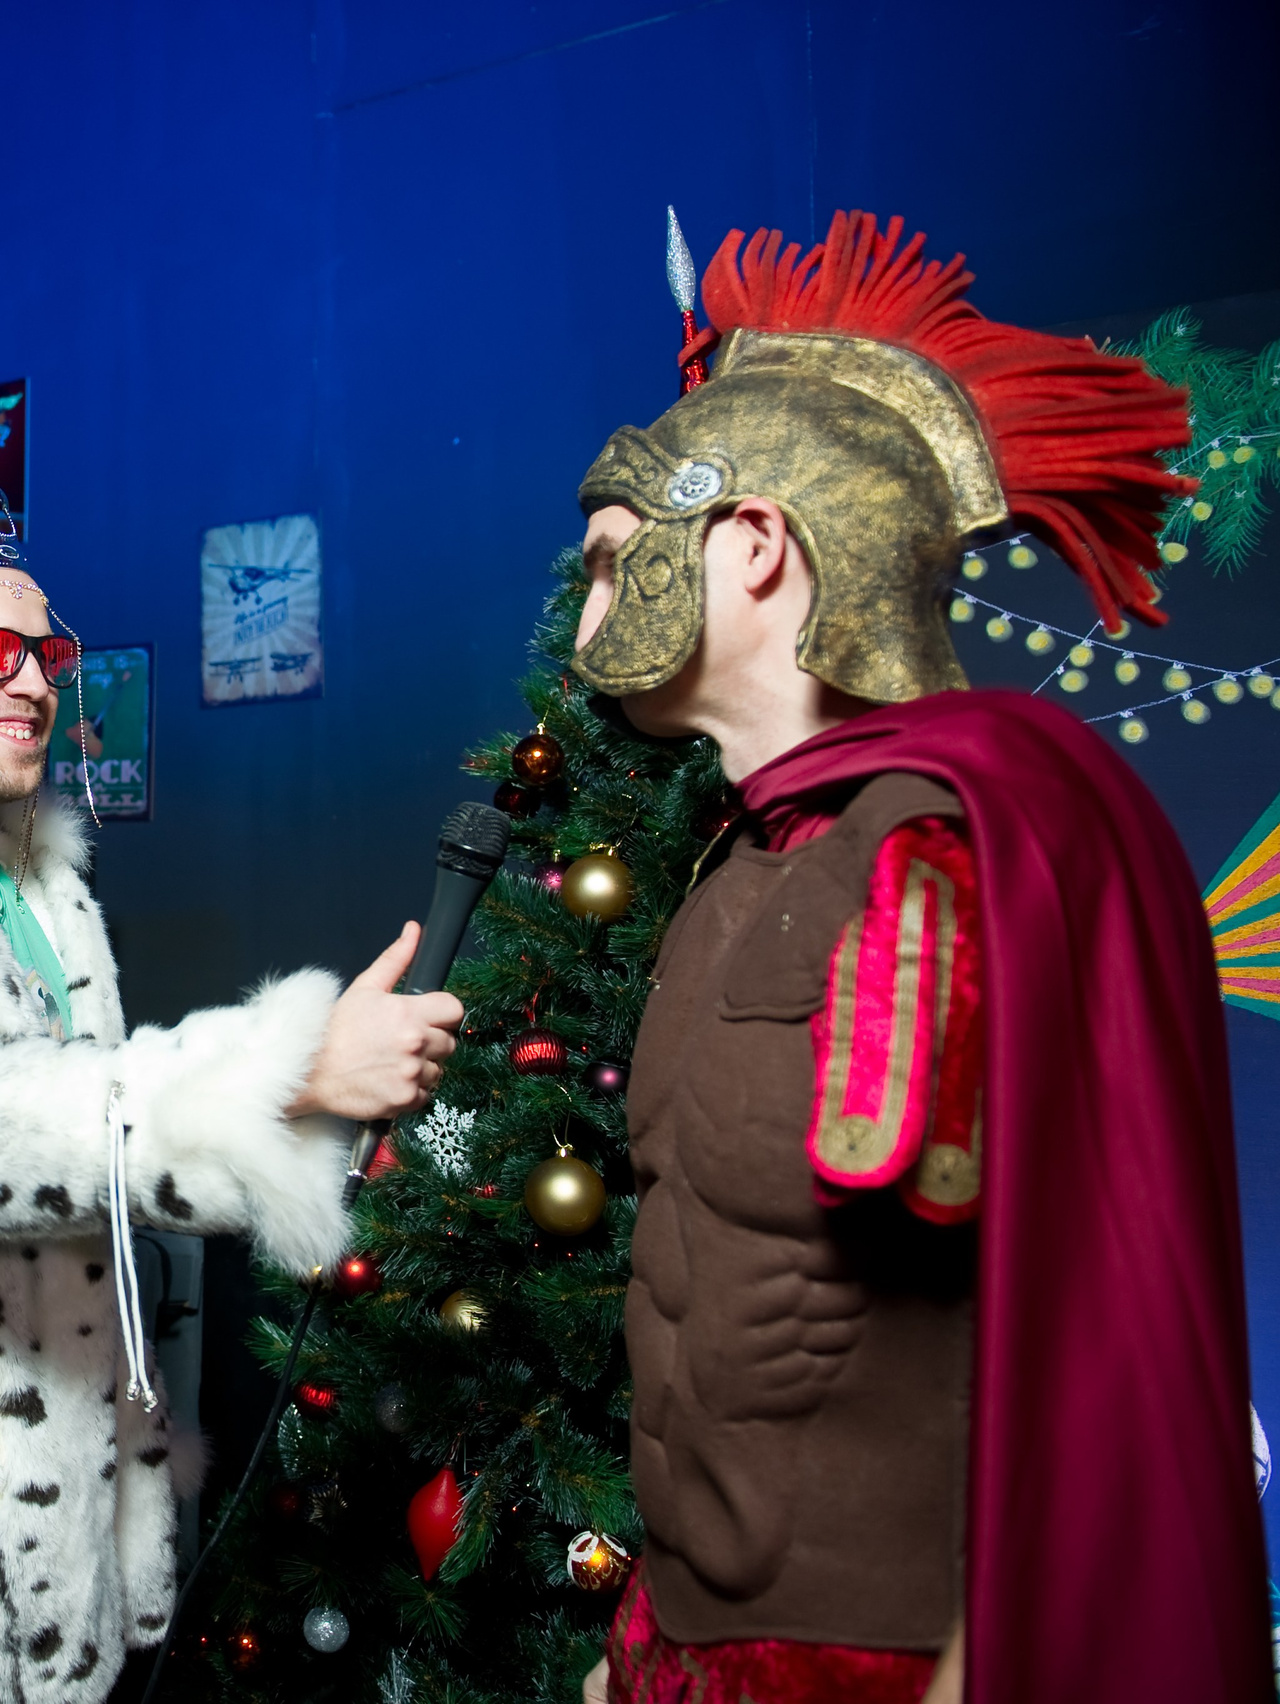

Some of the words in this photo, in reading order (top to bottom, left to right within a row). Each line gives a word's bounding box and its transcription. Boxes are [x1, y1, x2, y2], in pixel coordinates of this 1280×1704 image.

[80, 656, 107, 671] HIS
[55, 759, 143, 785] ROCK
[72, 793, 143, 807] OLL
